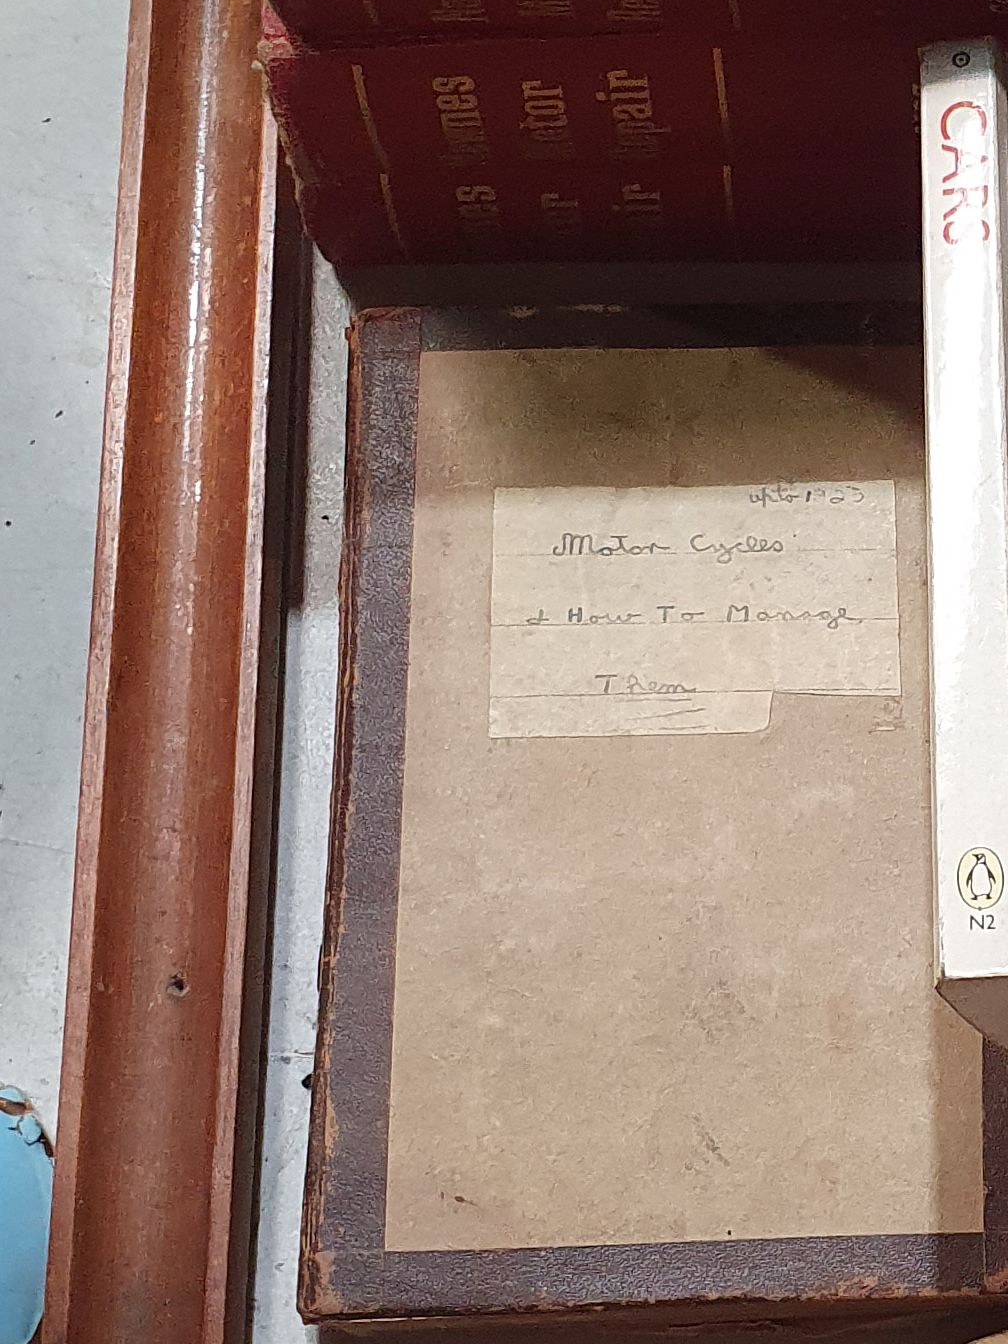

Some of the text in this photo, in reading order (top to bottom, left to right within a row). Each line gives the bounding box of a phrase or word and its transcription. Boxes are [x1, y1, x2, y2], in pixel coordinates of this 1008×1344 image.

[940, 100, 990, 245] CARS
[553, 533, 670, 557] Motor
[568, 607, 641, 624] How
[657, 606, 705, 624] To
[595, 674, 696, 695] Them
[969, 914, 997, 931] N2
